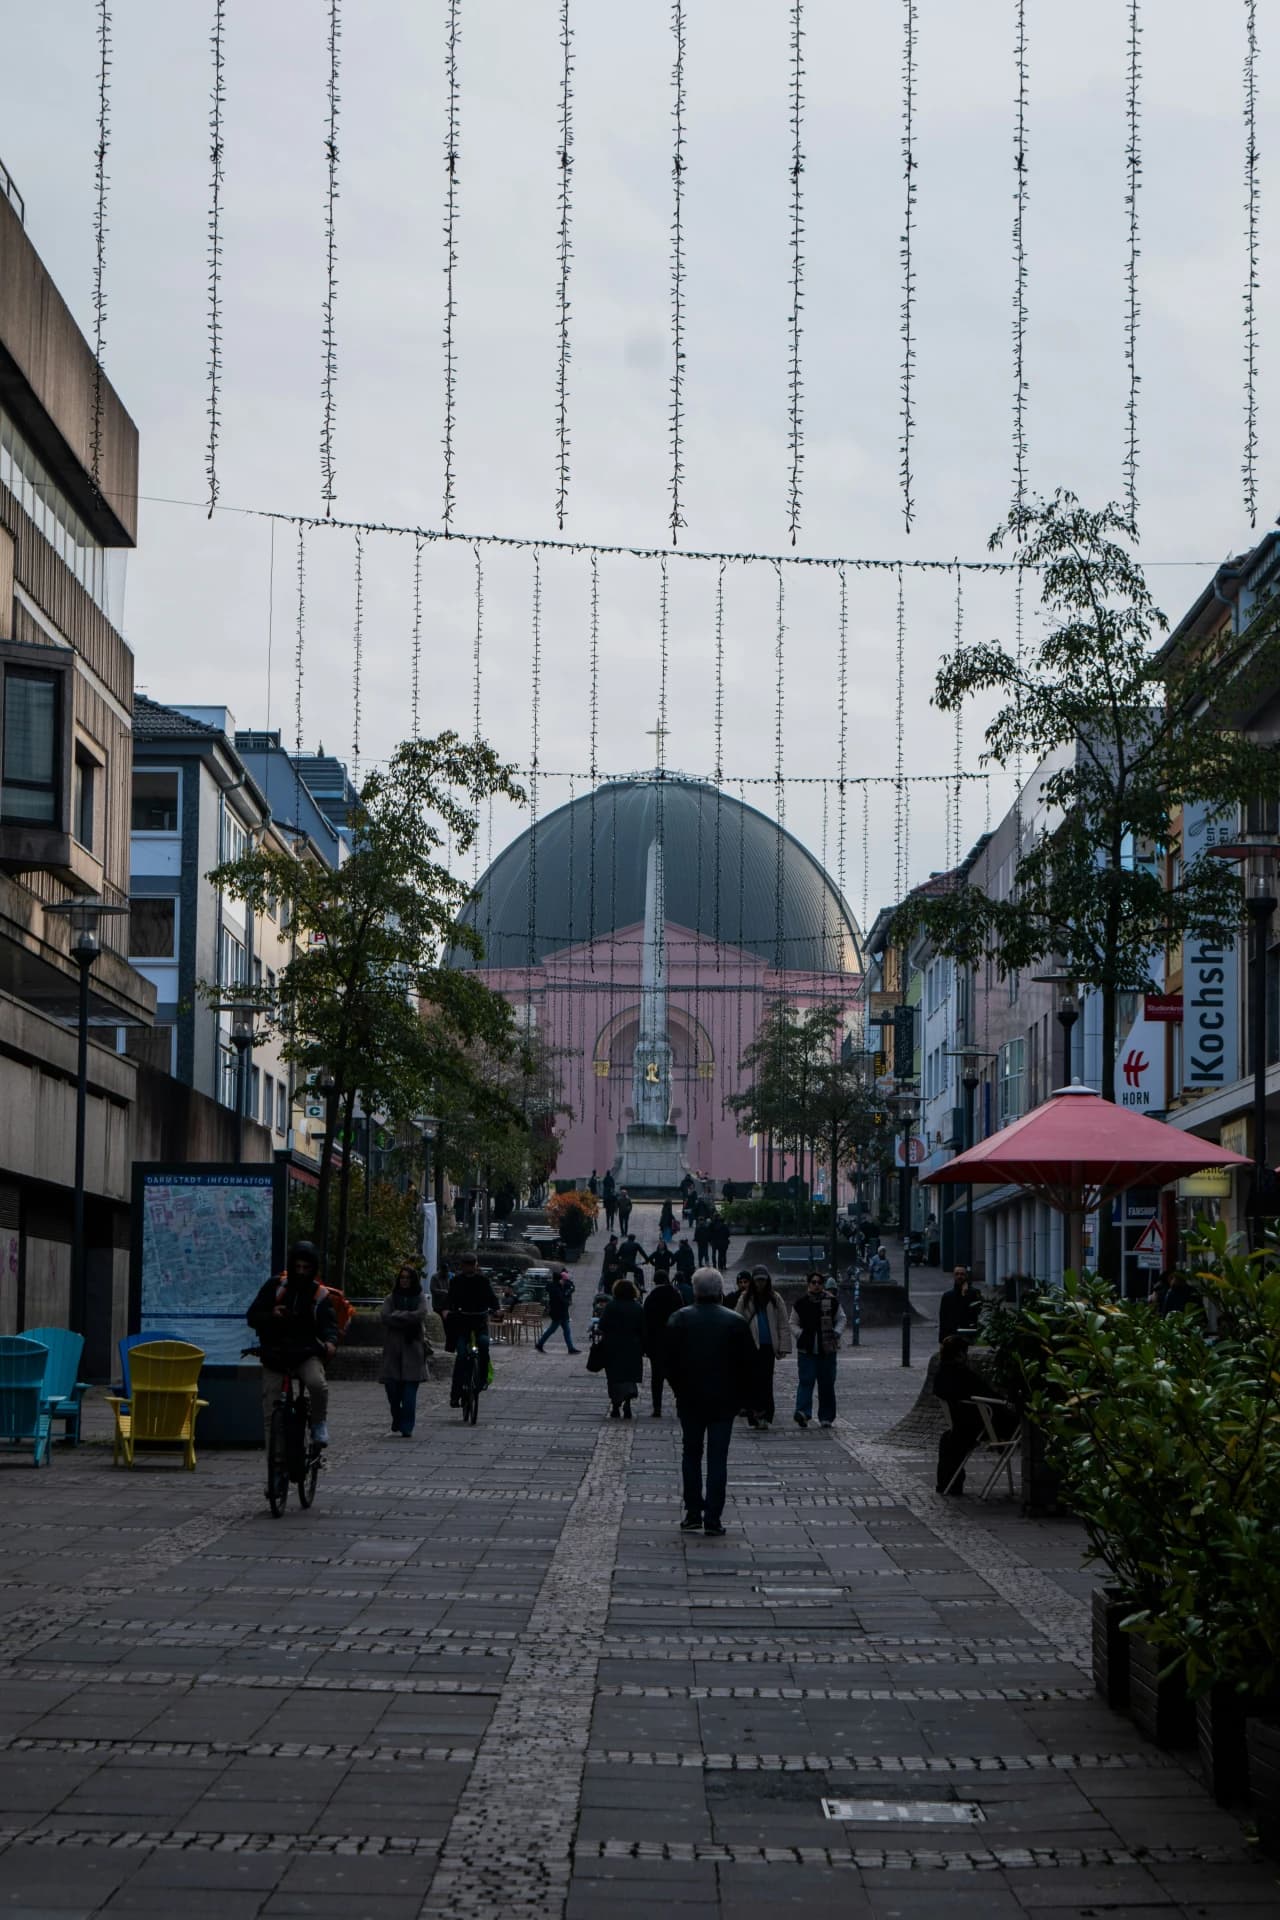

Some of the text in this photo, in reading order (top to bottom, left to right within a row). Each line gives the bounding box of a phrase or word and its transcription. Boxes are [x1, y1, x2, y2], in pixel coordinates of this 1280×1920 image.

[1191, 942, 1224, 1081] Kochsh
[1122, 1091, 1150, 1106] HORN
[146, 1176, 272, 1186] DARMSTADT INFORMATION
[1128, 1207, 1158, 1217] FANSHOP
